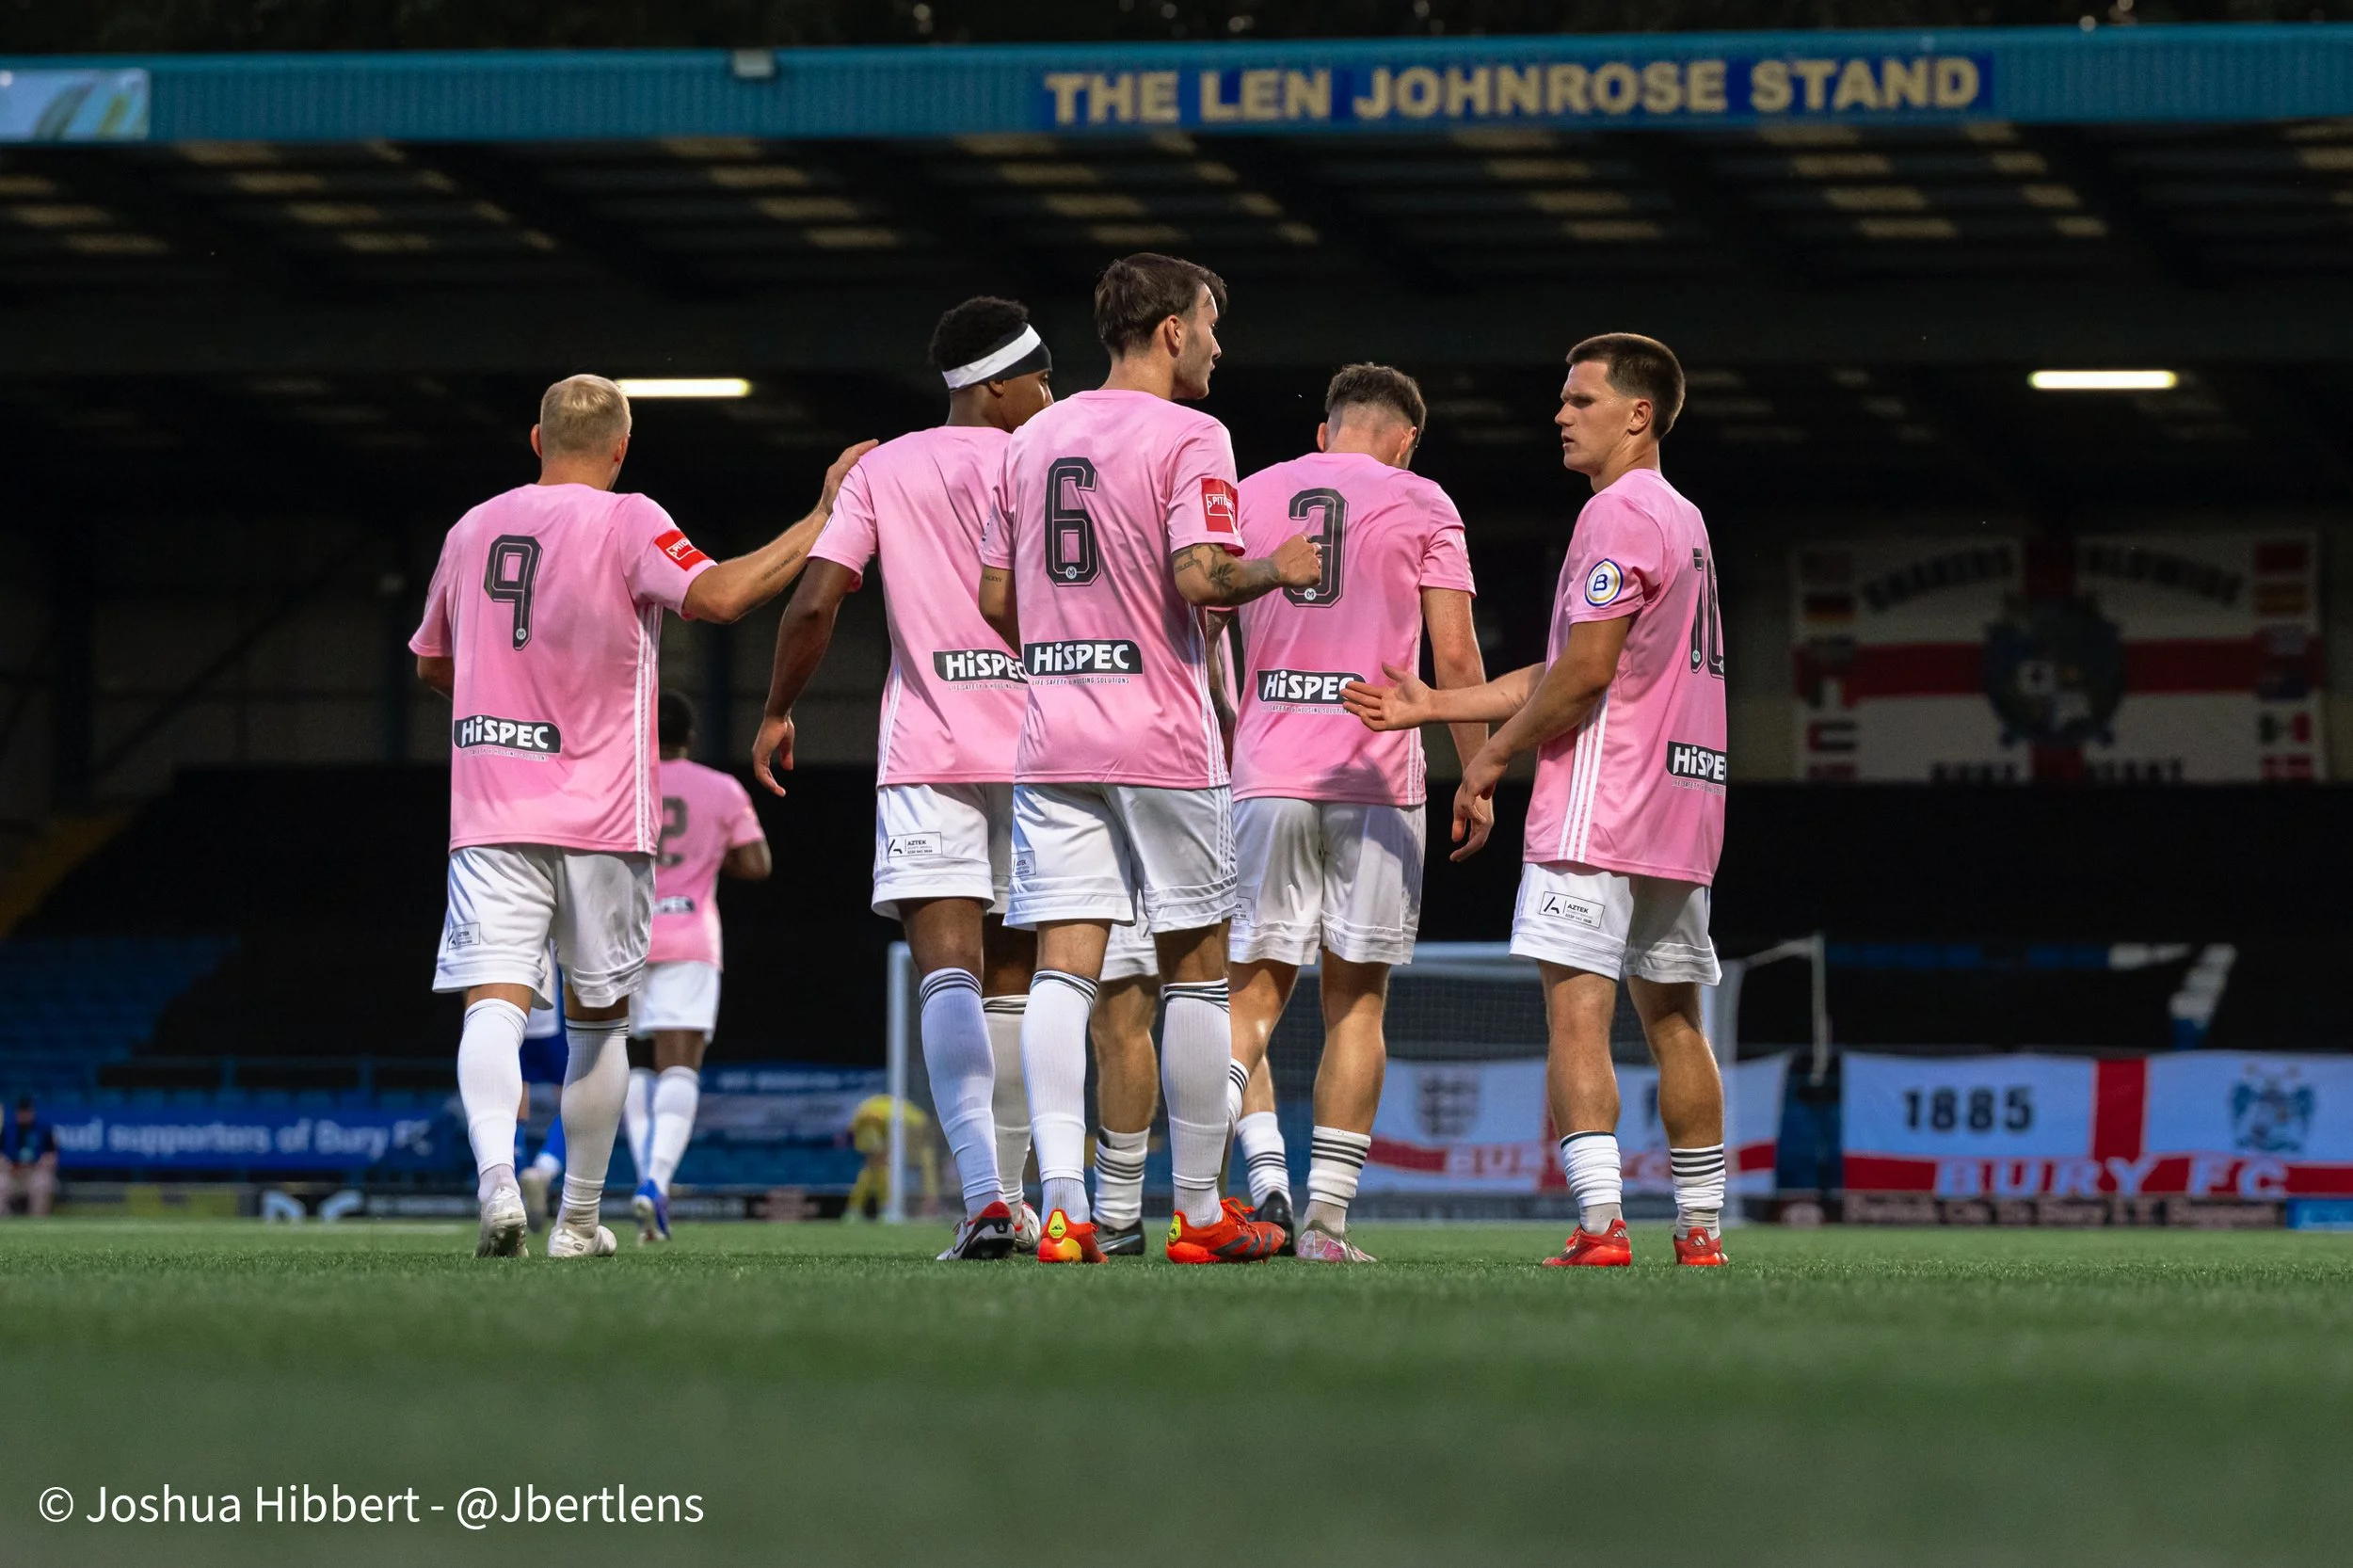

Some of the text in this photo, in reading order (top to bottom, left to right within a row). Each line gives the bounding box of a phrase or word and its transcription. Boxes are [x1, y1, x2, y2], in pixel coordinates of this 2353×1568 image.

[1045, 56, 1981, 124] THE LEN JOHNROSE STAND
[1045, 457, 1101, 586] 6
[1283, 488, 1349, 608] 3
[485, 535, 543, 651] 9
[1593, 573, 1609, 592] B
[1033, 643, 1130, 675] HiSPEC
[461, 715, 549, 749] HiSPEC
[1673, 746, 1726, 781] HiSPE
[656, 795, 689, 868] 2
[1567, 904, 1589, 914] AZTEK
[1904, 1086, 2032, 1133] 1885
[108, 1120, 271, 1160] supporters
[276, 1118, 312, 1154] of
[315, 1118, 390, 1160] Bury
[1934, 1153, 2289, 1200] BURY FC
